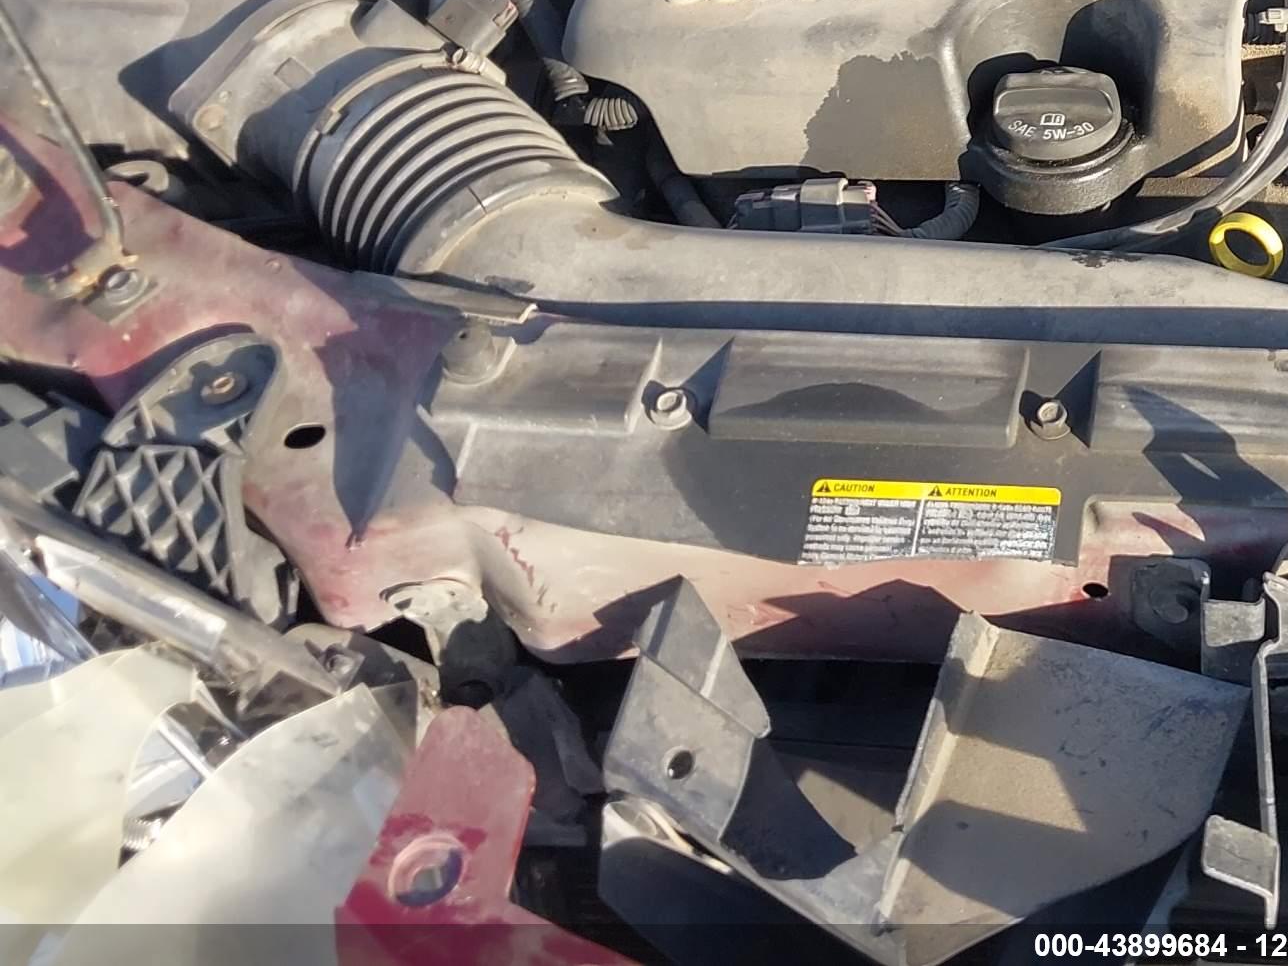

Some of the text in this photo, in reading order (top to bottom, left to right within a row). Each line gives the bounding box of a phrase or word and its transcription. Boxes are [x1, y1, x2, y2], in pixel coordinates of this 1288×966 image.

[1008, 120, 1095, 140] SAE 5W-30
[833, 483, 876, 493] CAUTION
[945, 487, 998, 498] ATTENTION
